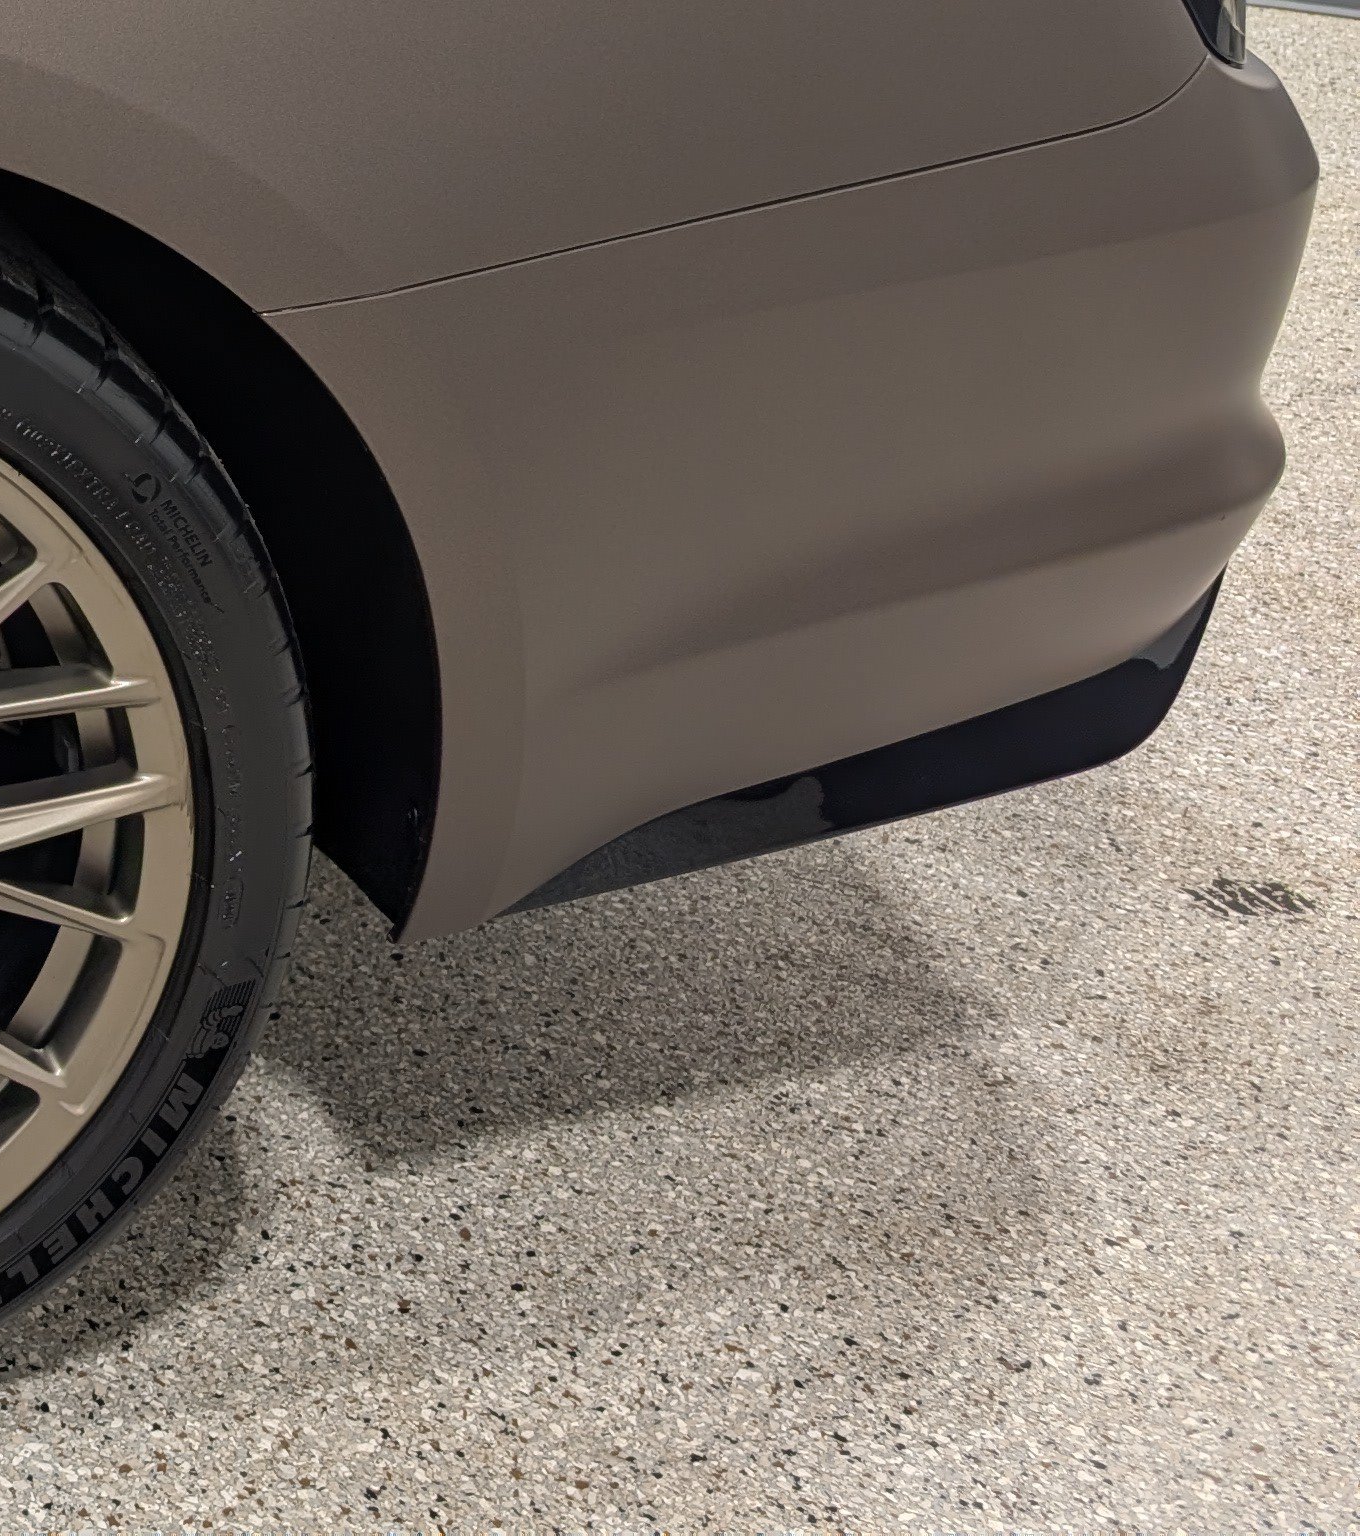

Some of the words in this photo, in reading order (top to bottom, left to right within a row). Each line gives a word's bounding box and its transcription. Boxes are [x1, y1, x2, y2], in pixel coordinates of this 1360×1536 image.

[148, 508, 171, 541] Total
[166, 538, 213, 603] Performance
[160, 499, 214, 569] MICHELIN
